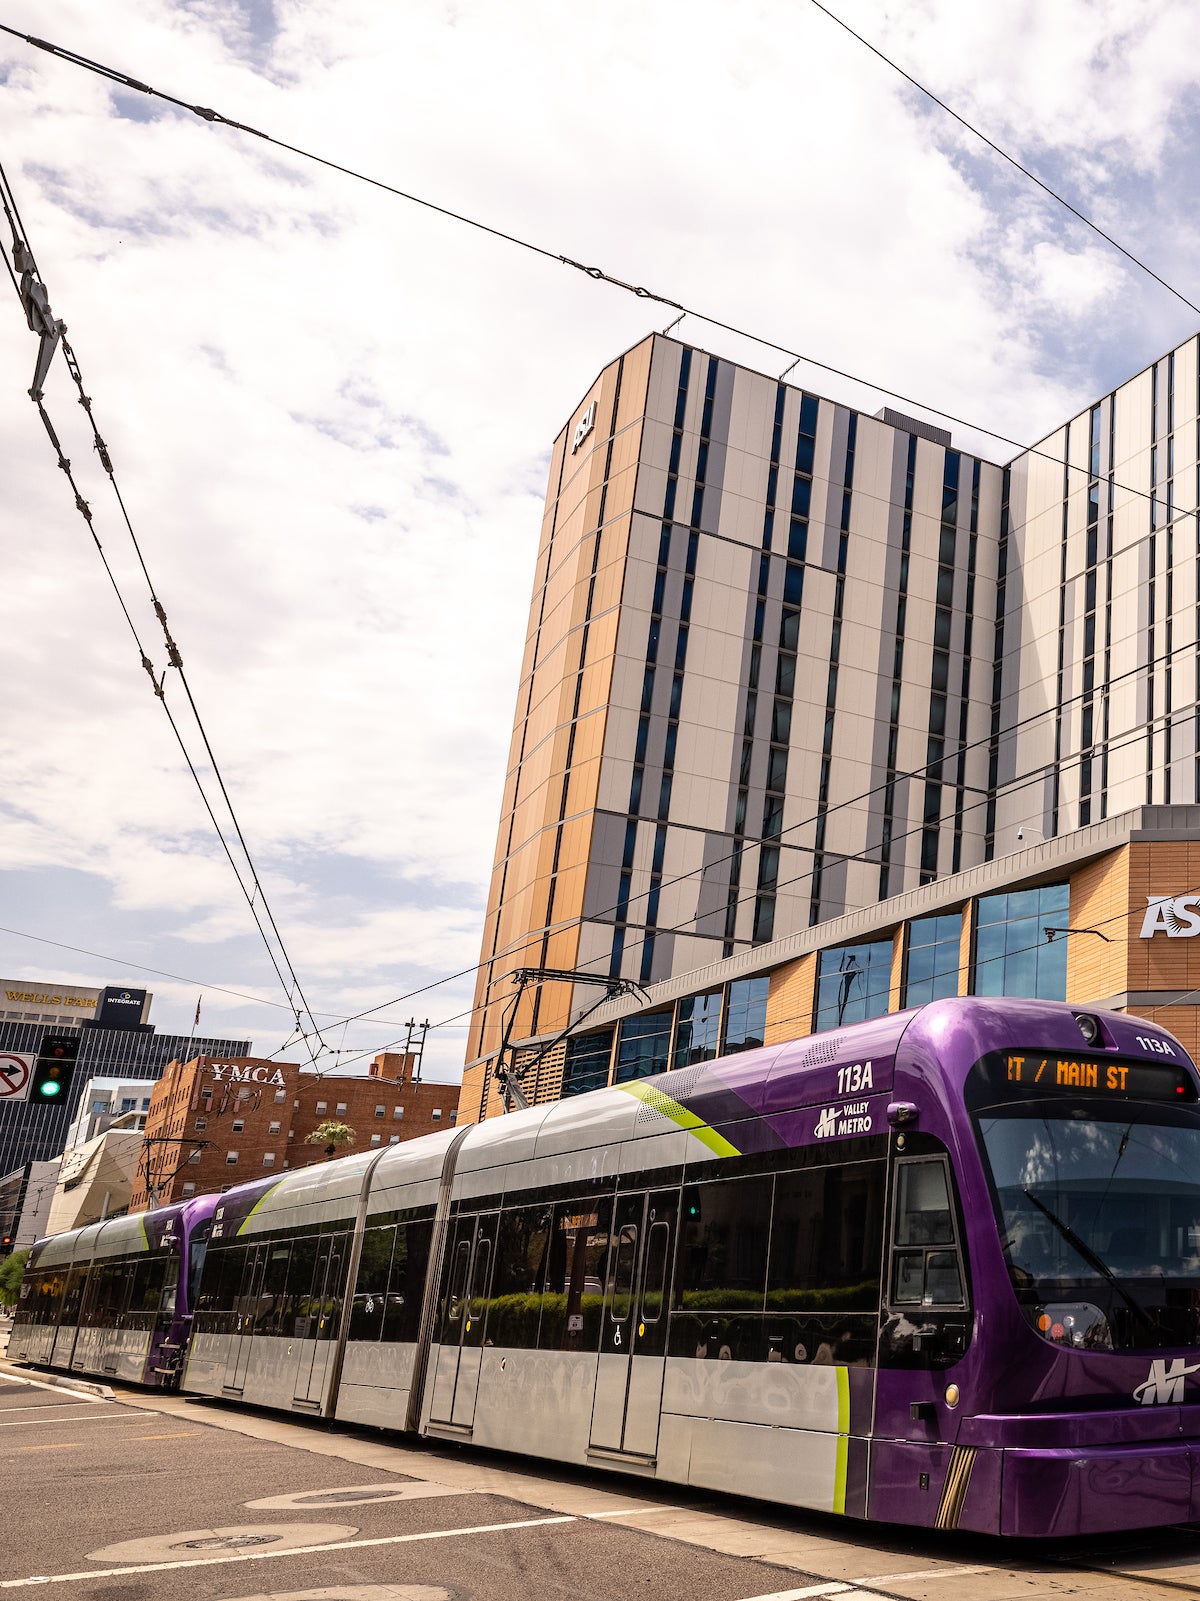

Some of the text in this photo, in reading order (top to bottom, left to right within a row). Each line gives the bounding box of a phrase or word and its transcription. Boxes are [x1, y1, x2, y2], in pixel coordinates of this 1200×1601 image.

[6, 991, 98, 1008] WELLS FAR
[1135, 1036, 1176, 1057] 113A
[211, 1063, 286, 1086] YMCA
[837, 1061, 873, 1094] 113A
[1056, 1060, 1098, 1088] MAIN
[1106, 1066, 1129, 1091] ST
[843, 1101, 870, 1116] VALLEY
[837, 1115, 872, 1136] METRO
